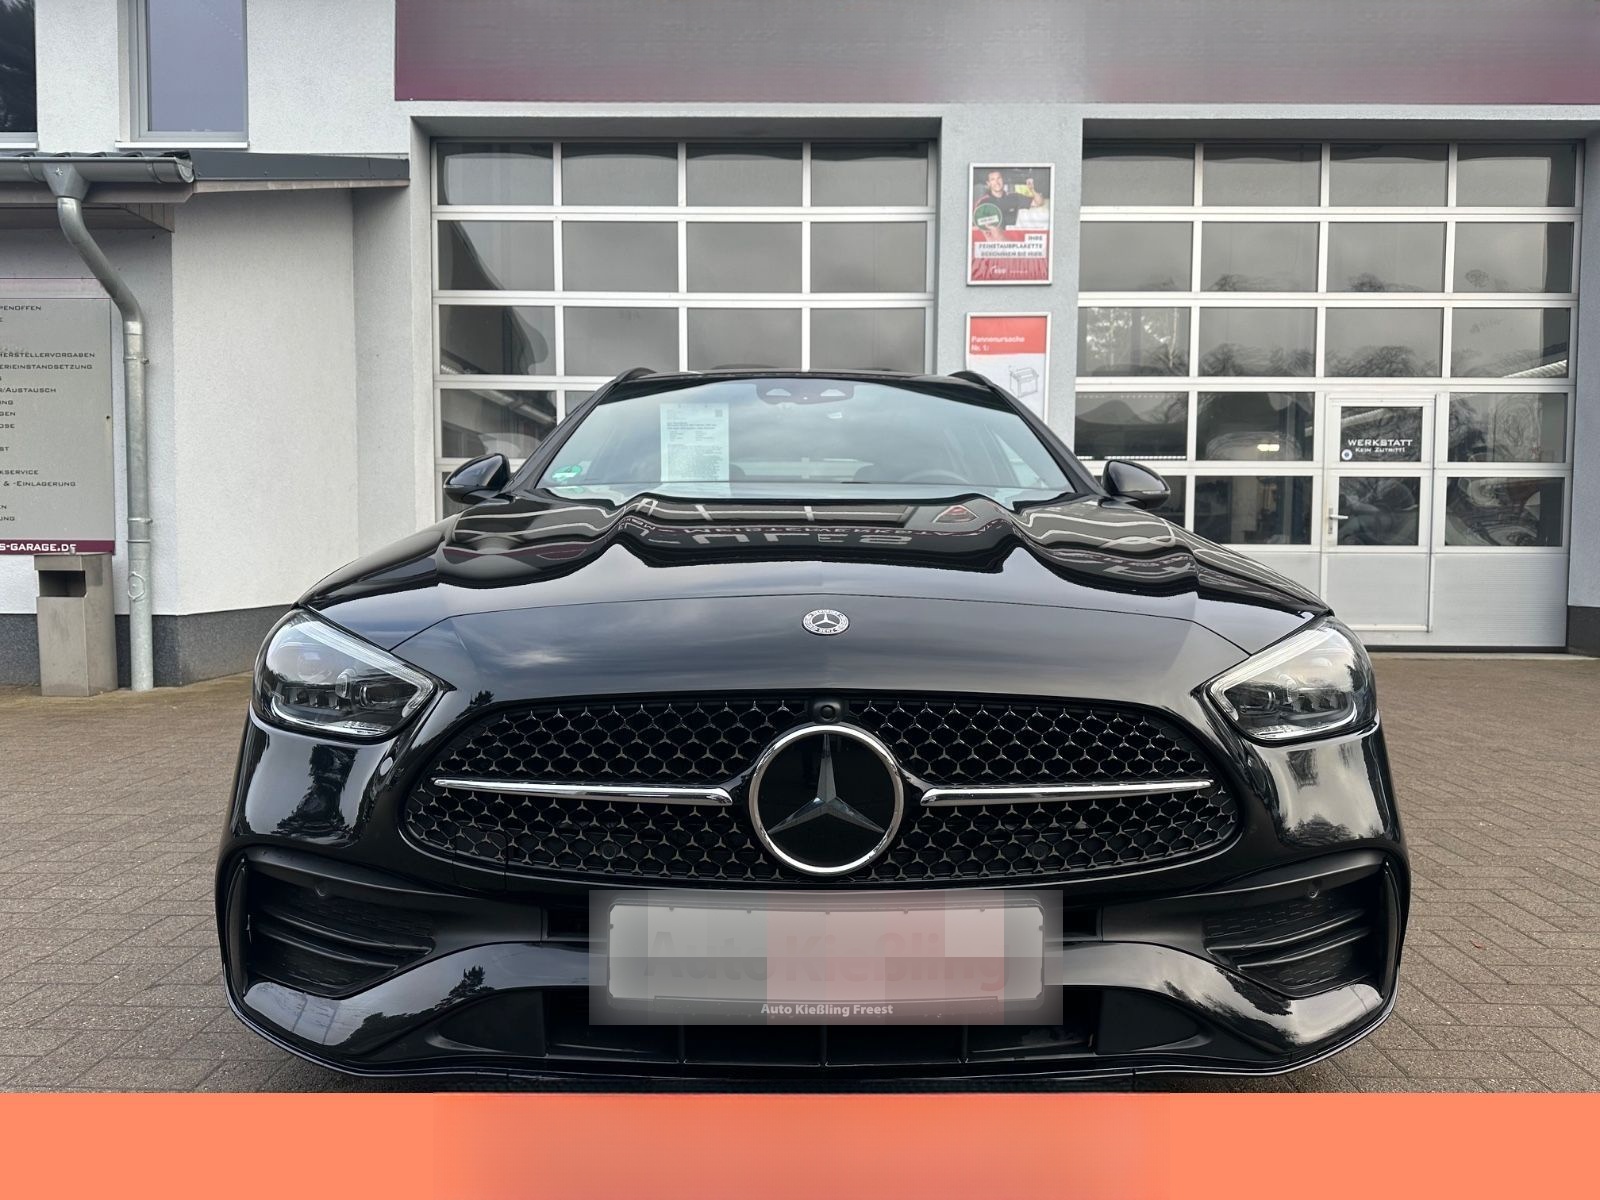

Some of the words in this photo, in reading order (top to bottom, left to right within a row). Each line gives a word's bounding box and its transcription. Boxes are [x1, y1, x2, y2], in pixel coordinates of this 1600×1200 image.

[643, 931, 775, 981] Auto
[760, 1003, 792, 1014] Auto
[795, 1003, 850, 1017] Kießling
[853, 1004, 894, 1014] Freest
